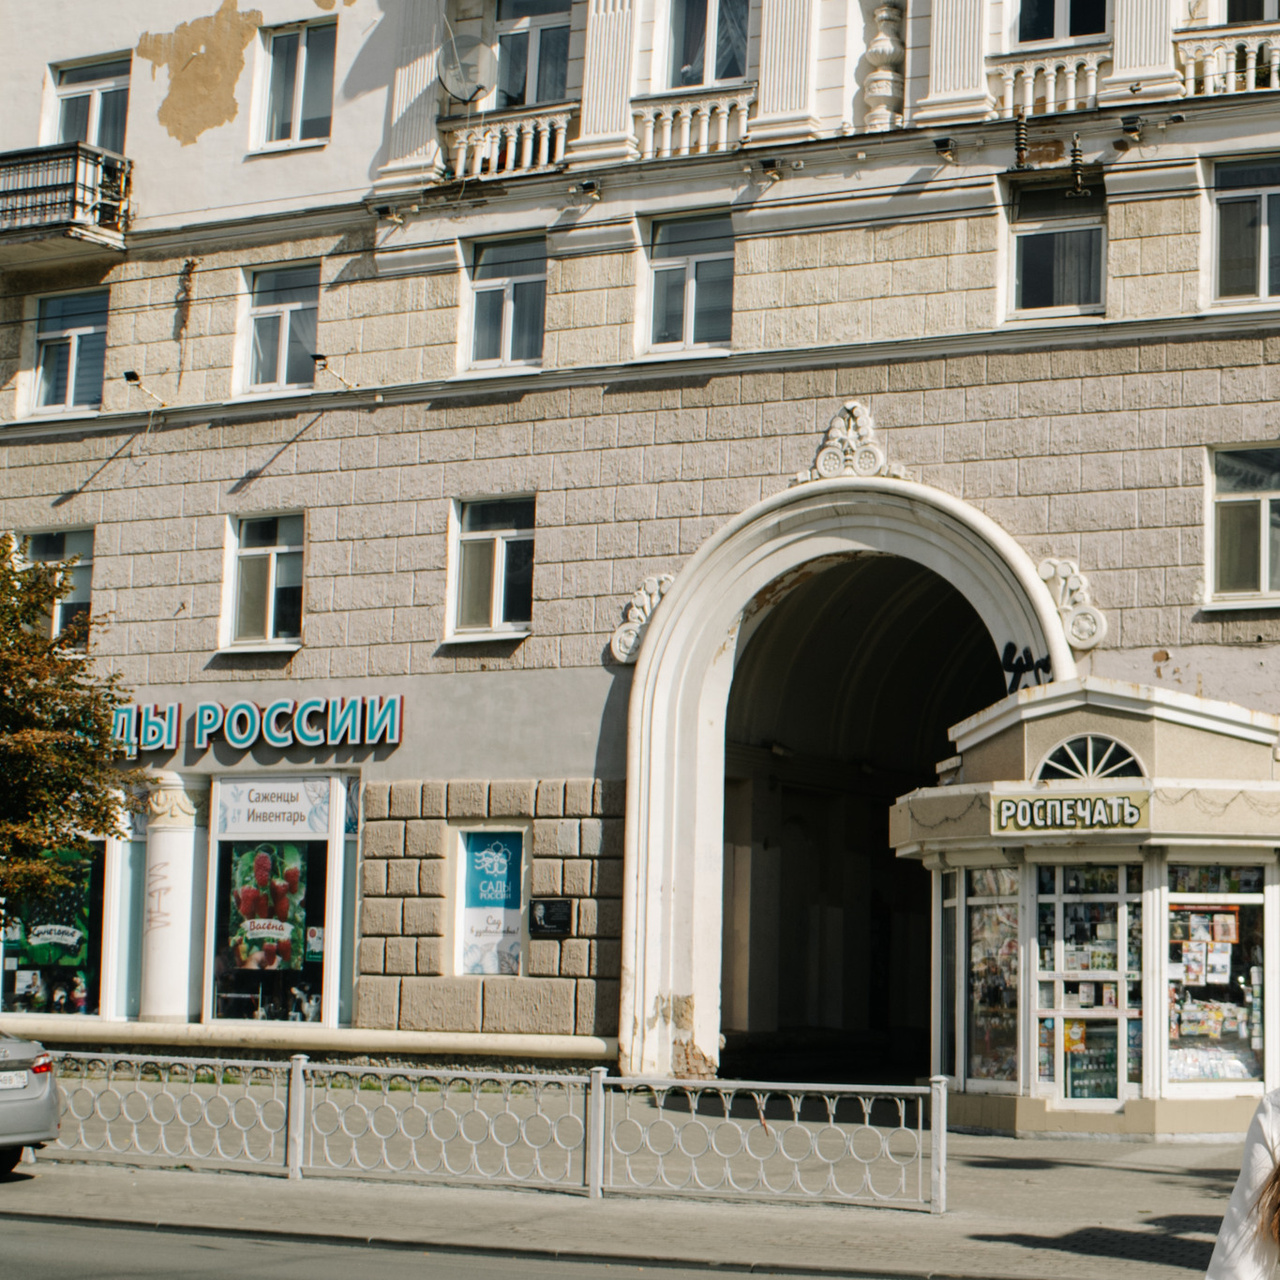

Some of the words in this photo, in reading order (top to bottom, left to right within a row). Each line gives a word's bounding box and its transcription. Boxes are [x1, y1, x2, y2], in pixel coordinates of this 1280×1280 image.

[194, 694, 403, 749] РОССИИ
[248, 788, 300, 804] Саженцы
[247, 808, 307, 825] Инвентарь
[999, 797, 1140, 828] РОСПЕЧАТЬ
[479, 880, 511, 893] САДЫ
[249, 921, 285, 932] Васёна
